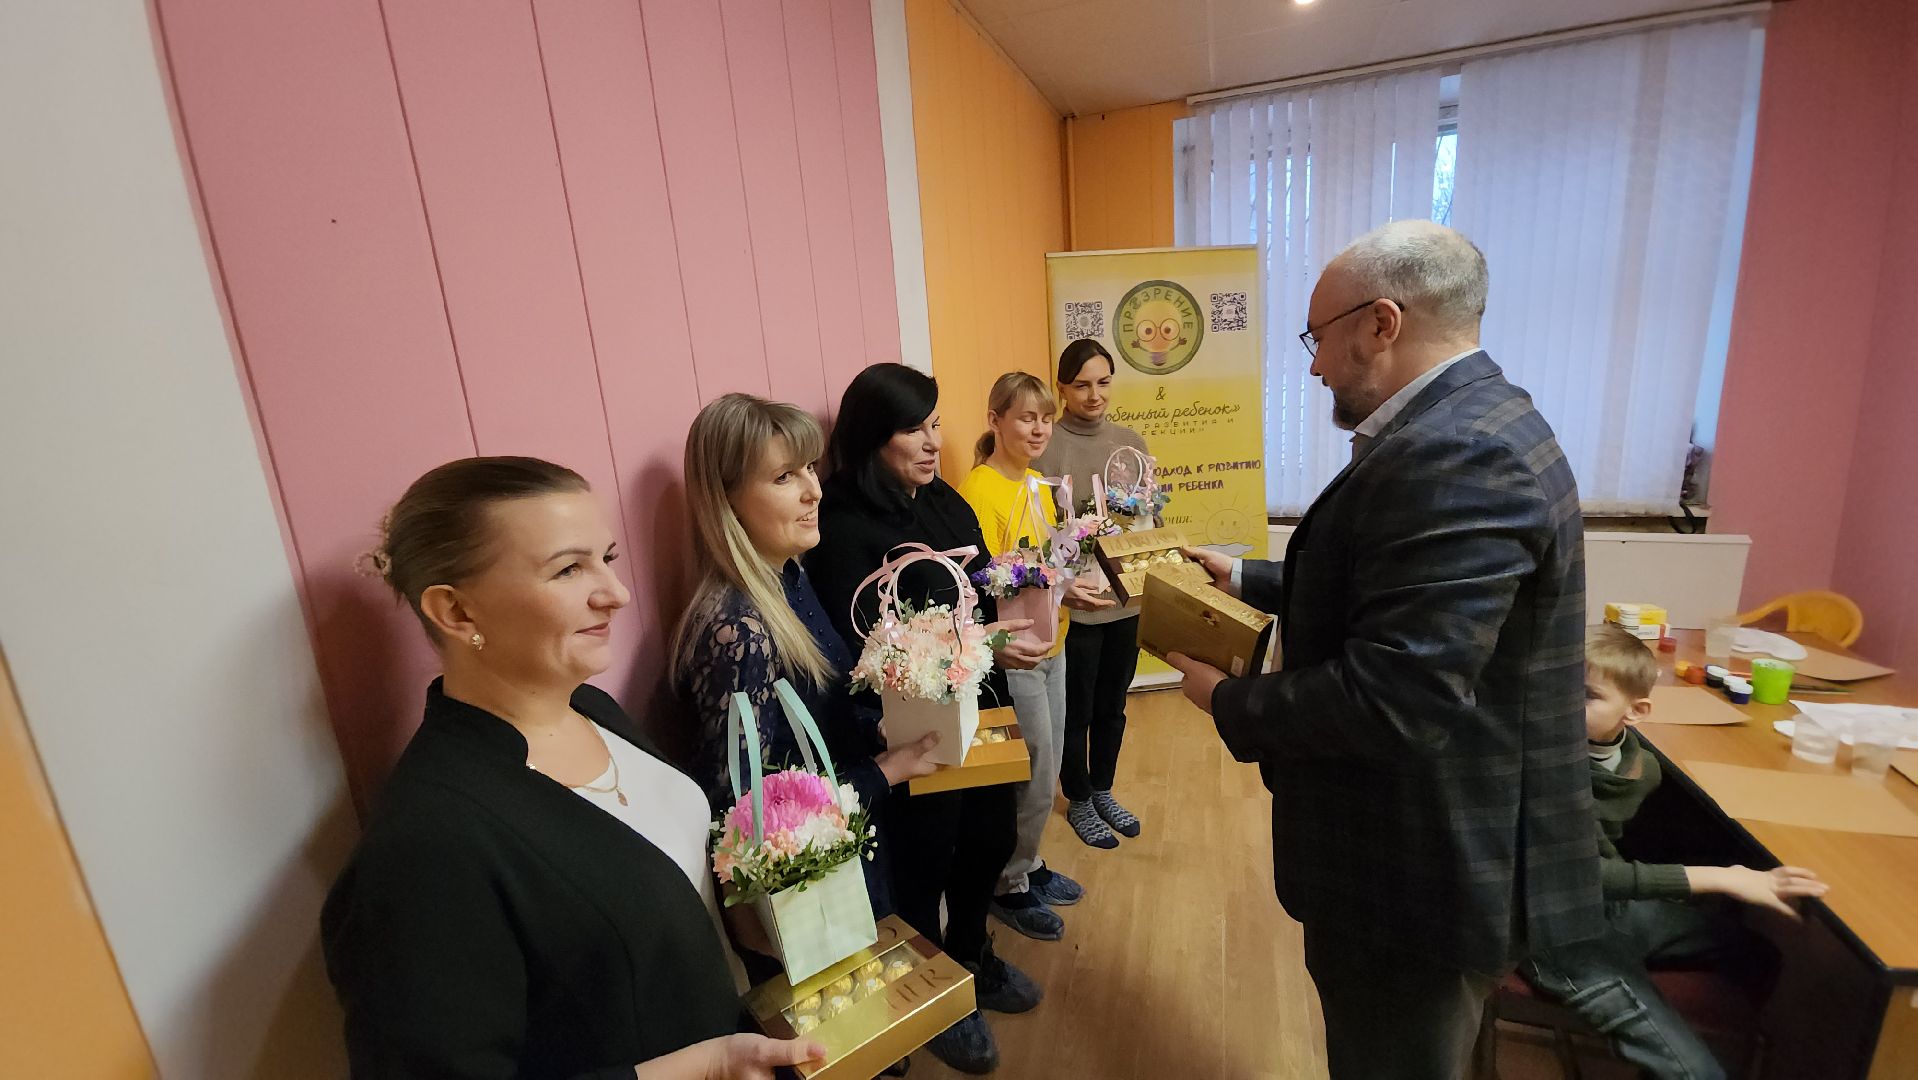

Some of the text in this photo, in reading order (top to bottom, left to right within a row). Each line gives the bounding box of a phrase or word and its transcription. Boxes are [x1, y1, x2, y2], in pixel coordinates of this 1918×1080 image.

[1155, 386, 1167, 400] &
[1104, 406, 1170, 422] обенный
[1141, 427, 1205, 436] РЕКЦИИ»
[1196, 464, 1204, 475] К
[1208, 459, 1262, 473] РАЗВИТИЮ
[1178, 480, 1225, 493] РЕБЕНКА
